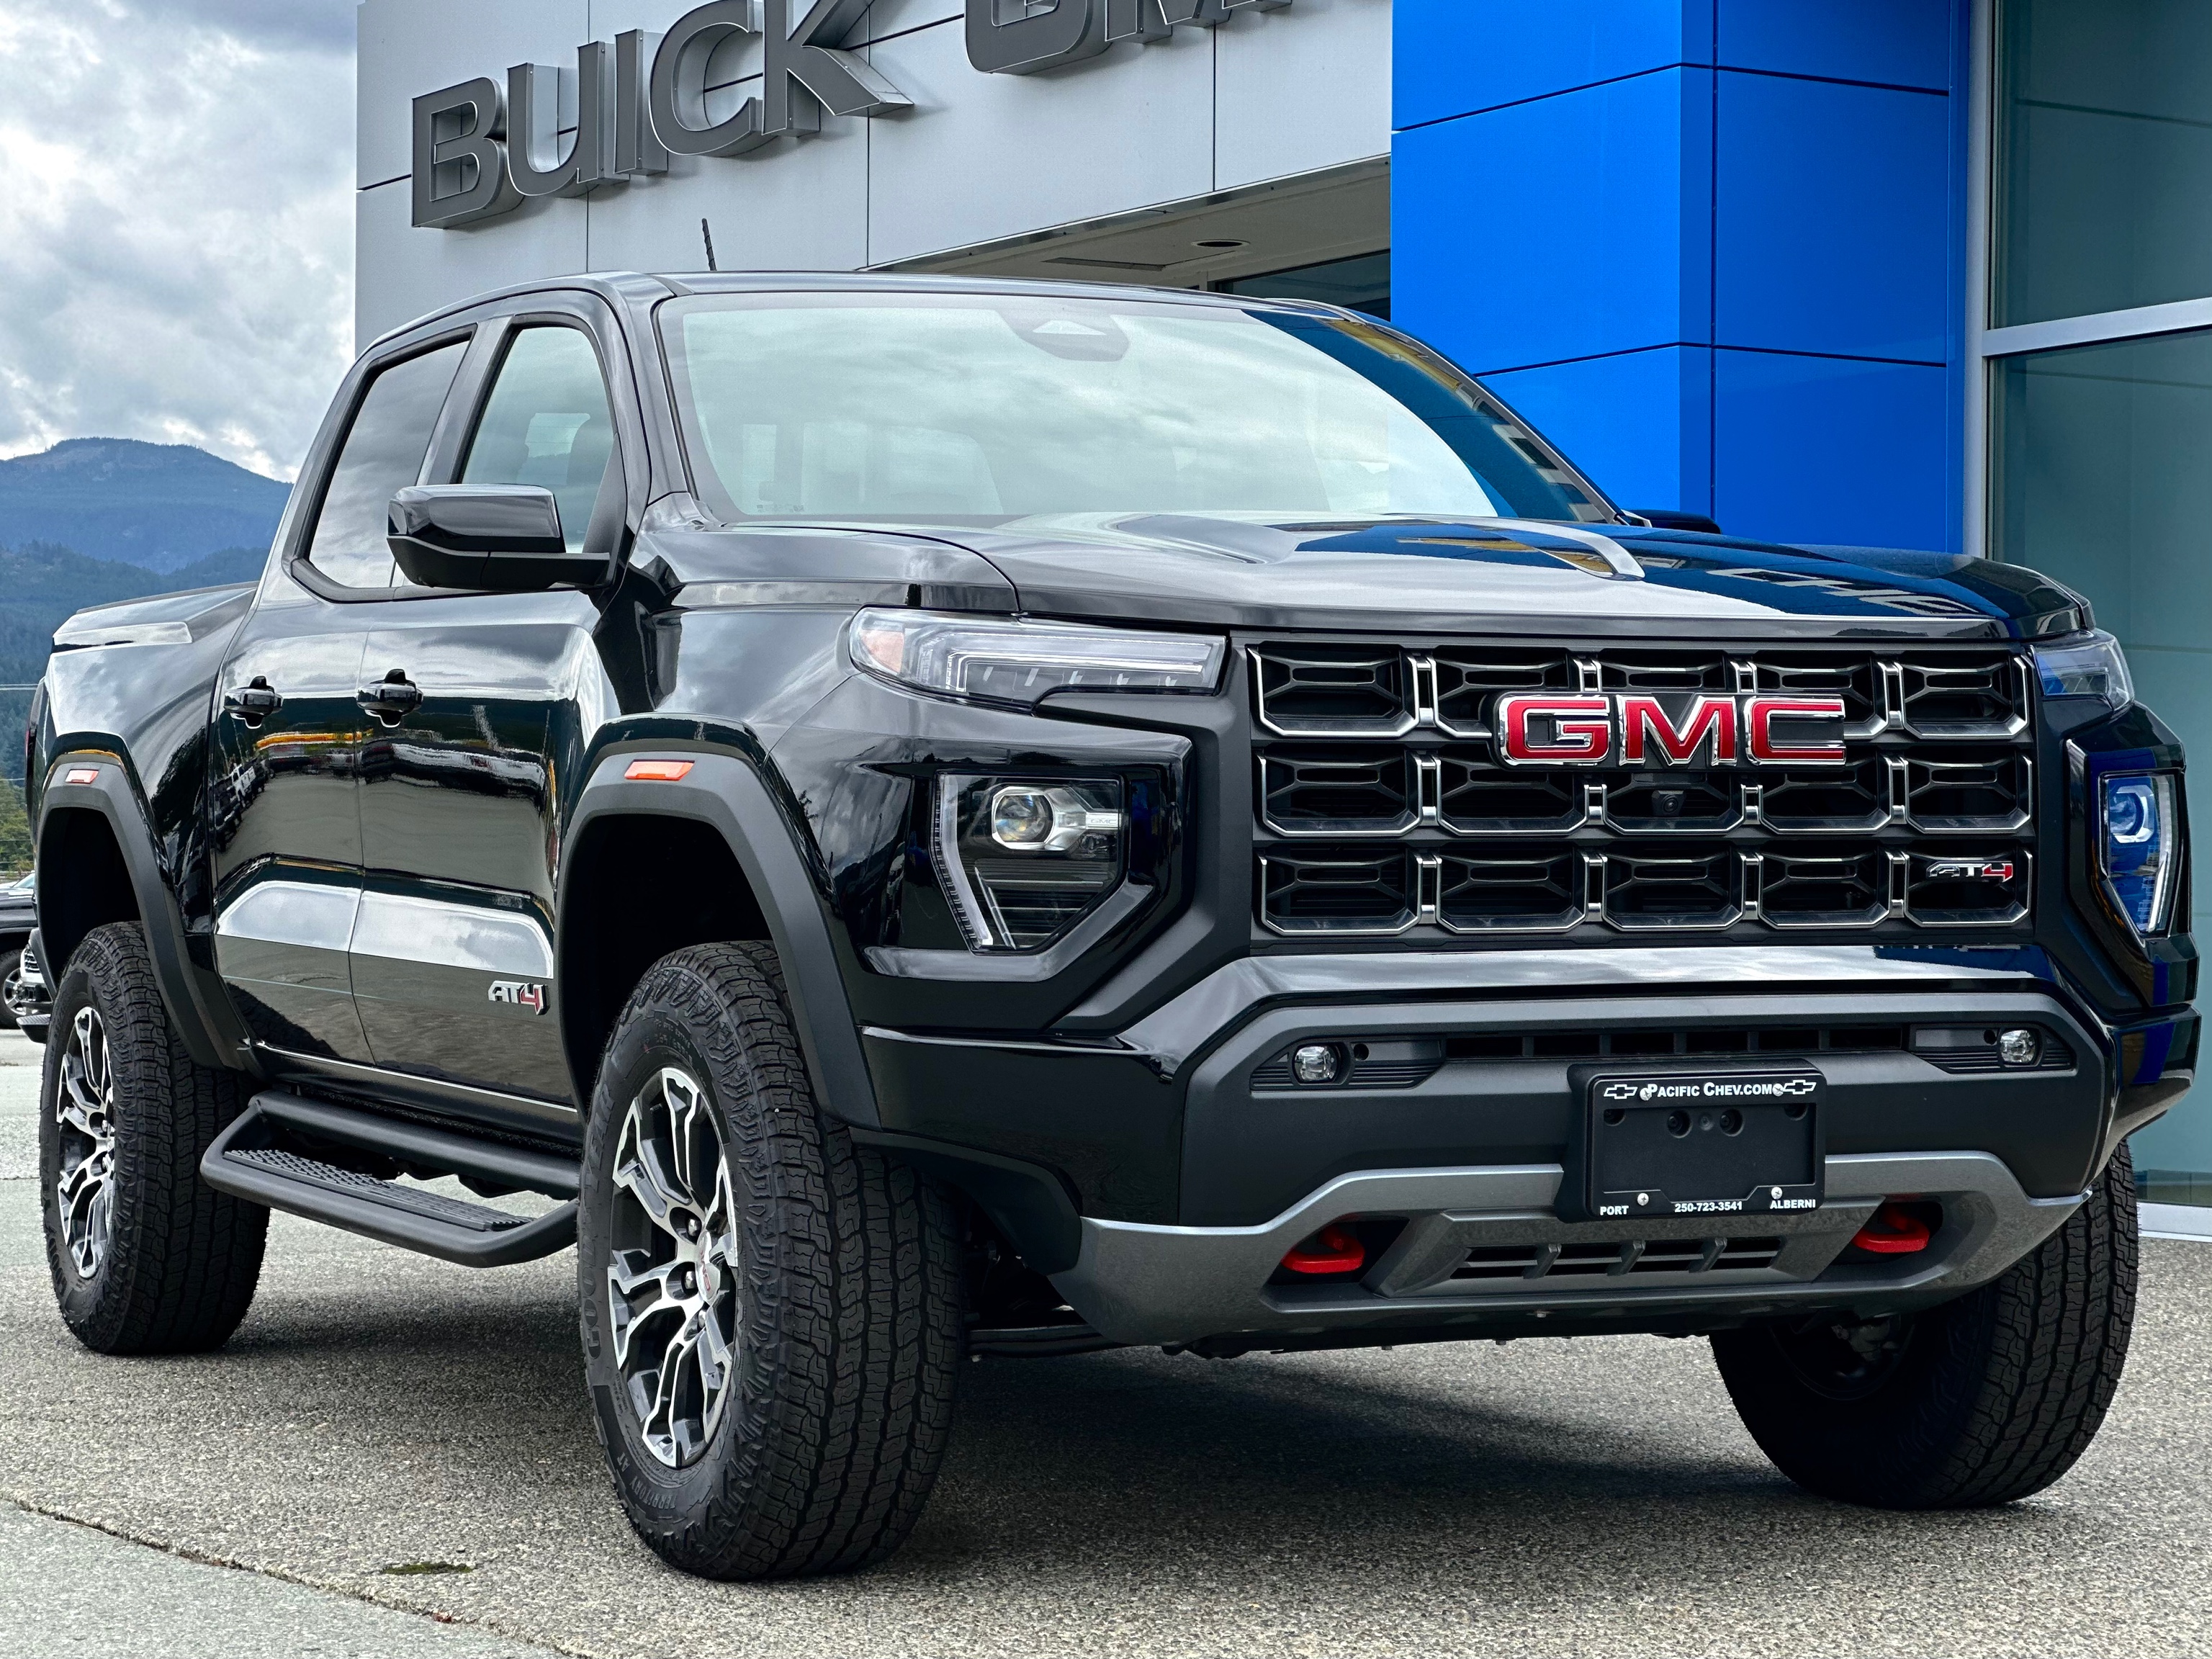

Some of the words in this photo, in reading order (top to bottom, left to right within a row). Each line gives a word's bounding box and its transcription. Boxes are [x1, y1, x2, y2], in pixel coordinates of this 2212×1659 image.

[411, 0, 914, 229] BUICK
[1499, 694, 1845, 766] GMC
[1925, 862, 2014, 883] AT4
[488, 980, 549, 1015] AT4
[1647, 1083, 1700, 1098] PACIFIC
[1703, 1082, 1773, 1097] CHEV.COM
[1599, 1205, 1629, 1216] PORT
[1674, 1200, 1743, 1213] 250-723-3541
[1769, 1198, 1817, 1210] ALBERNI
[616, 1452, 631, 1473] AT
[629, 1476, 678, 1510] TERRITORY
